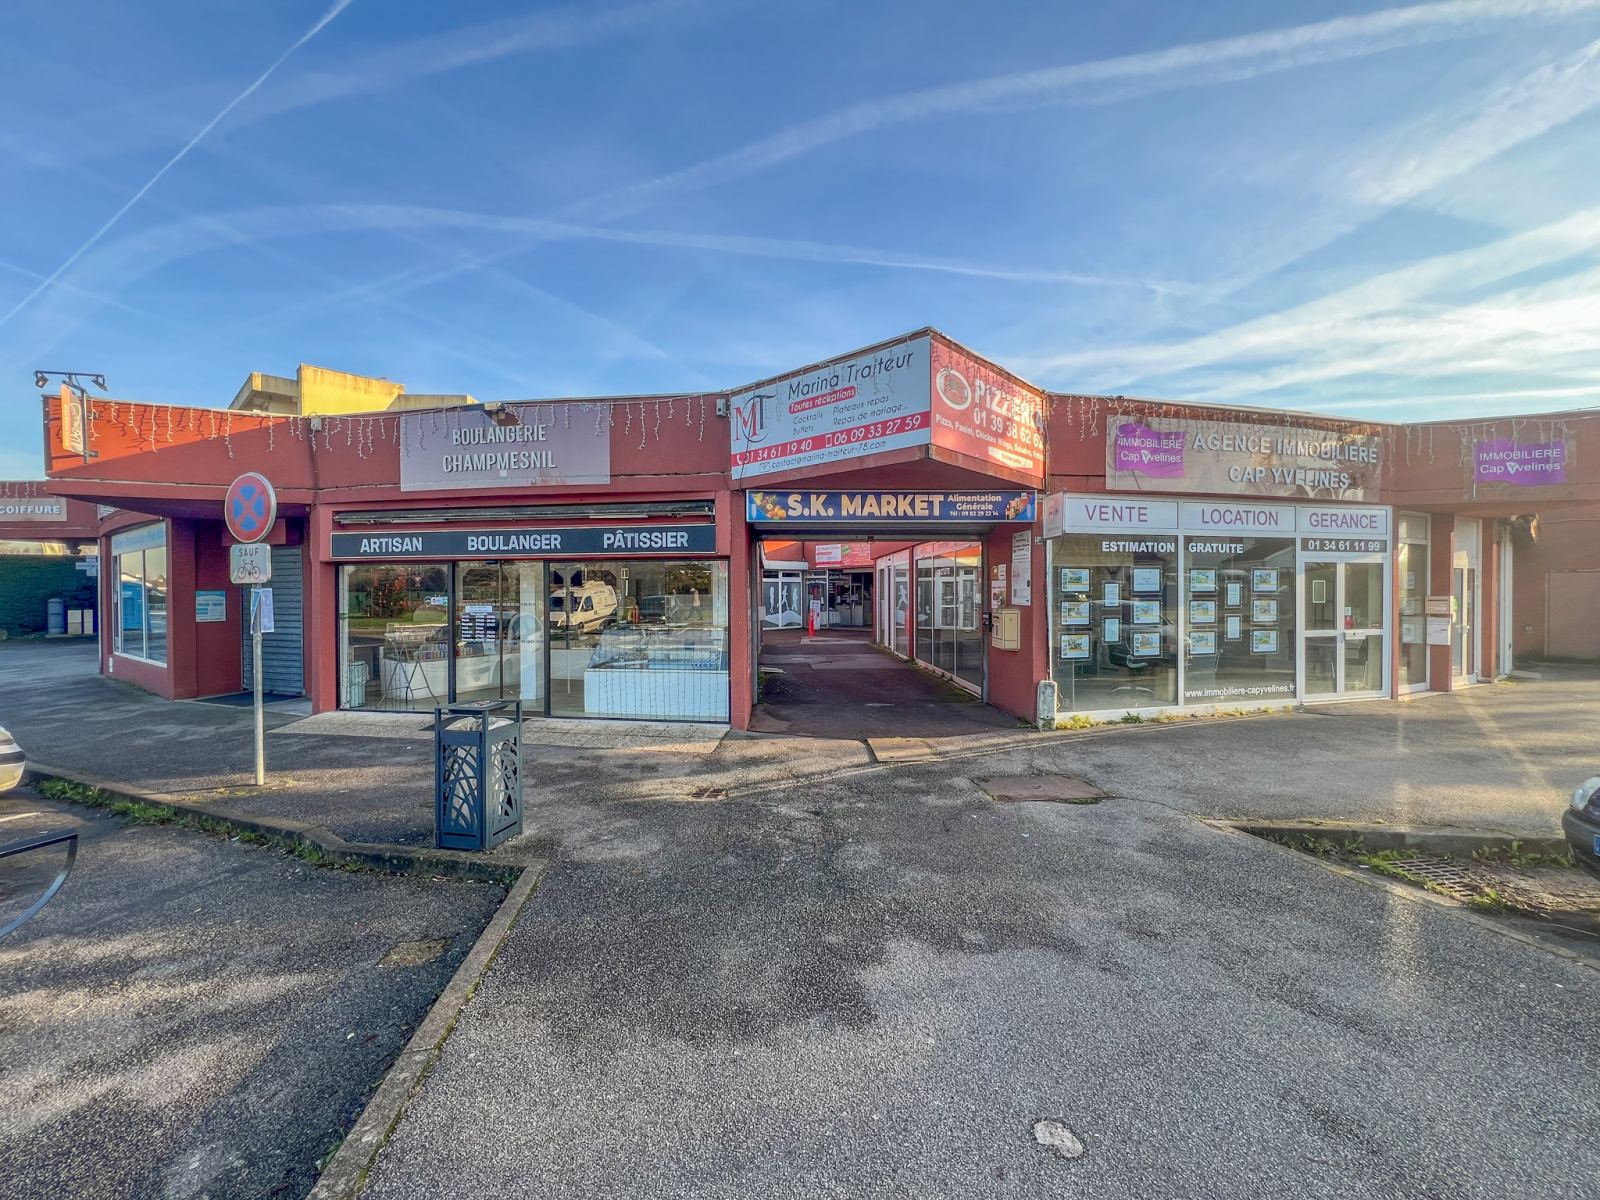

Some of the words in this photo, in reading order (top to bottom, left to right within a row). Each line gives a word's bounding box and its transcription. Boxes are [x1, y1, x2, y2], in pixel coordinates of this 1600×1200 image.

[788, 374, 839, 400] Marina
[847, 351, 914, 384] Traiteur
[790, 401, 813, 413] Toutes
[833, 402, 864, 415] Plateaux
[866, 395, 889, 407] repas
[793, 411, 823, 425] Cocktails
[833, 415, 856, 427] Repas
[857, 411, 868, 421] de
[936, 413, 954, 430] Pizza,
[955, 420, 975, 438] Panini,
[973, 407, 987, 428] 01
[990, 414, 1004, 434] 39
[1006, 420, 1018, 440] 38
[1020, 427, 1032, 445] 62
[452, 424, 547, 445] BOULANGERIE
[793, 424, 814, 436] Buffets
[833, 433, 848, 445] 06
[850, 427, 865, 441] 09
[867, 424, 882, 438] 33
[886, 419, 902, 435] 27
[904, 414, 921, 430] 59
[744, 452, 754, 464] 01
[757, 450, 768, 461] 34
[770, 446, 781, 458] 61
[786, 443, 797, 455] 19
[800, 439, 813, 452] 40
[1119, 436, 1183, 450] IMMOBILIERE
[1192, 433, 1270, 454] AGENCE
[1277, 440, 1378, 463] IMMOBILIERE
[442, 450, 557, 473] CHAMPMESNIL
[1120, 450, 1140, 463] Cap
[1140, 449, 1182, 465] Yvelines
[1479, 448, 1562, 461] IMMOBILIERE
[1480, 464, 1504, 475] Cap
[1505, 461, 1561, 474] Yvelines
[1228, 465, 1266, 483] CAP
[1269, 467, 1350, 490] YVELINES
[786, 493, 835, 517] S.K.
[841, 493, 944, 517] MARKET
[947, 493, 1002, 503] Alimentation
[956, 502, 993, 511] Générale
[0, 505, 61, 515] COIFFURE
[1084, 504, 1149, 524] VENTE
[1200, 507, 1279, 527] LOCATION
[1308, 512, 1378, 530] GERANCE
[359, 536, 423, 554] ARTISAN
[466, 533, 562, 552] BOULANGER
[603, 529, 689, 549] PÂTISSIER
[1101, 540, 1176, 554] ESTIMATION
[1308, 540, 1320, 551] 01
[1323, 540, 1336, 551] 34
[1338, 540, 1350, 551] 61
[1353, 541, 1365, 552] 11
[1367, 541, 1381, 552] 99
[238, 547, 259, 557] SAUF
[1187, 542, 1244, 555] GRATUITE
[1184, 684, 1296, 699] www.immobiliere-capyvelines.fr
